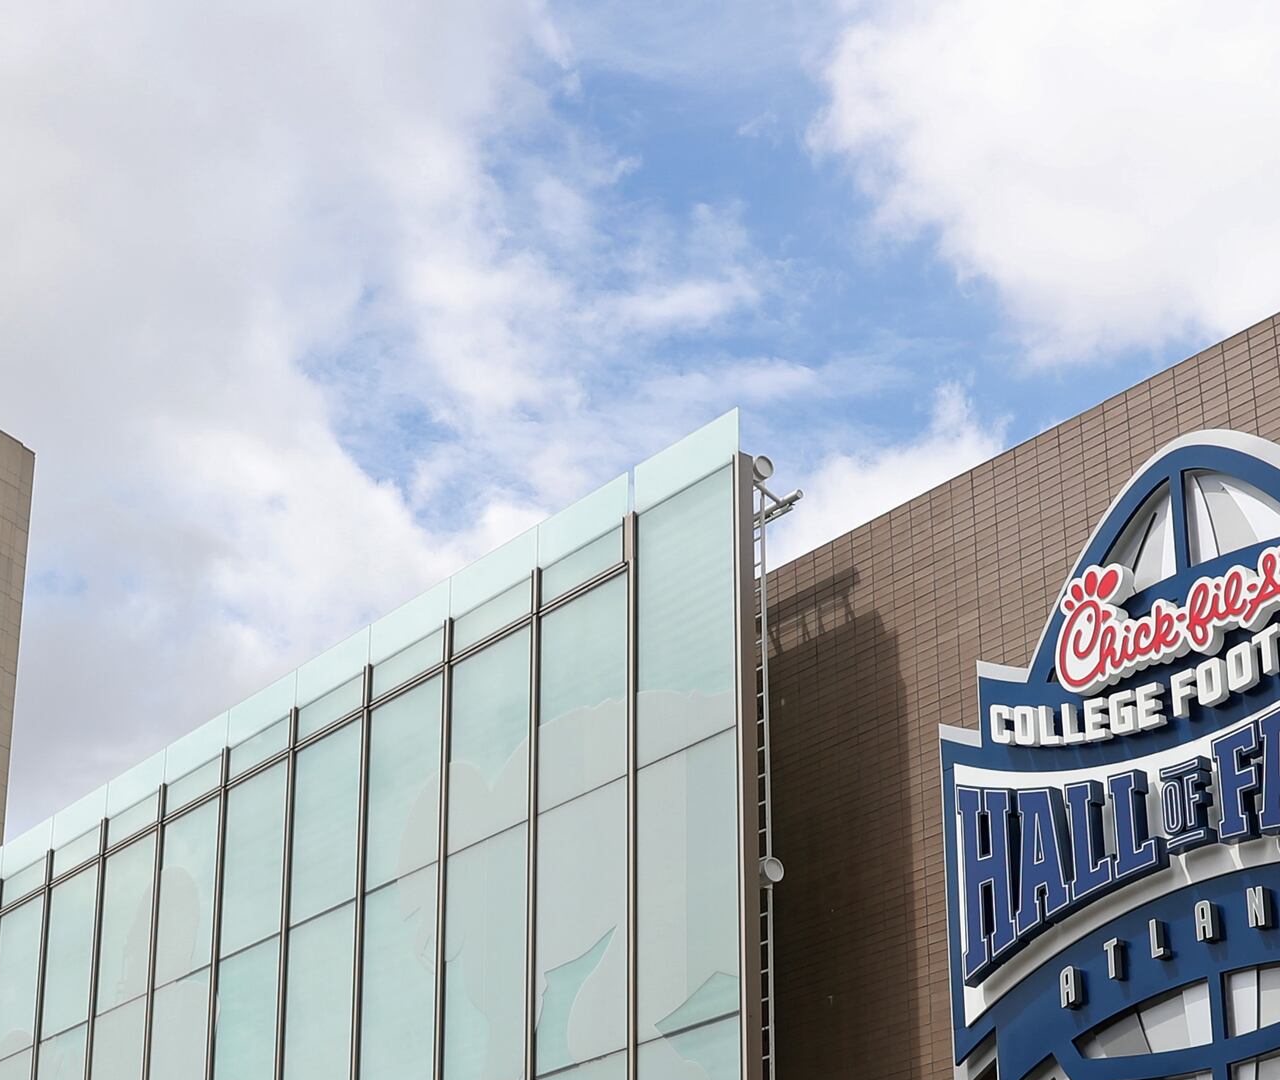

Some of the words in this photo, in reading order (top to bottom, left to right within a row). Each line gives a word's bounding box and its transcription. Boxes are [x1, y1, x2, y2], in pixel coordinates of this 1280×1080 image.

[989, 682, 1168, 747] COLLEGE
[955, 768, 1165, 986] HALL
[1160, 764, 1212, 848] OF
